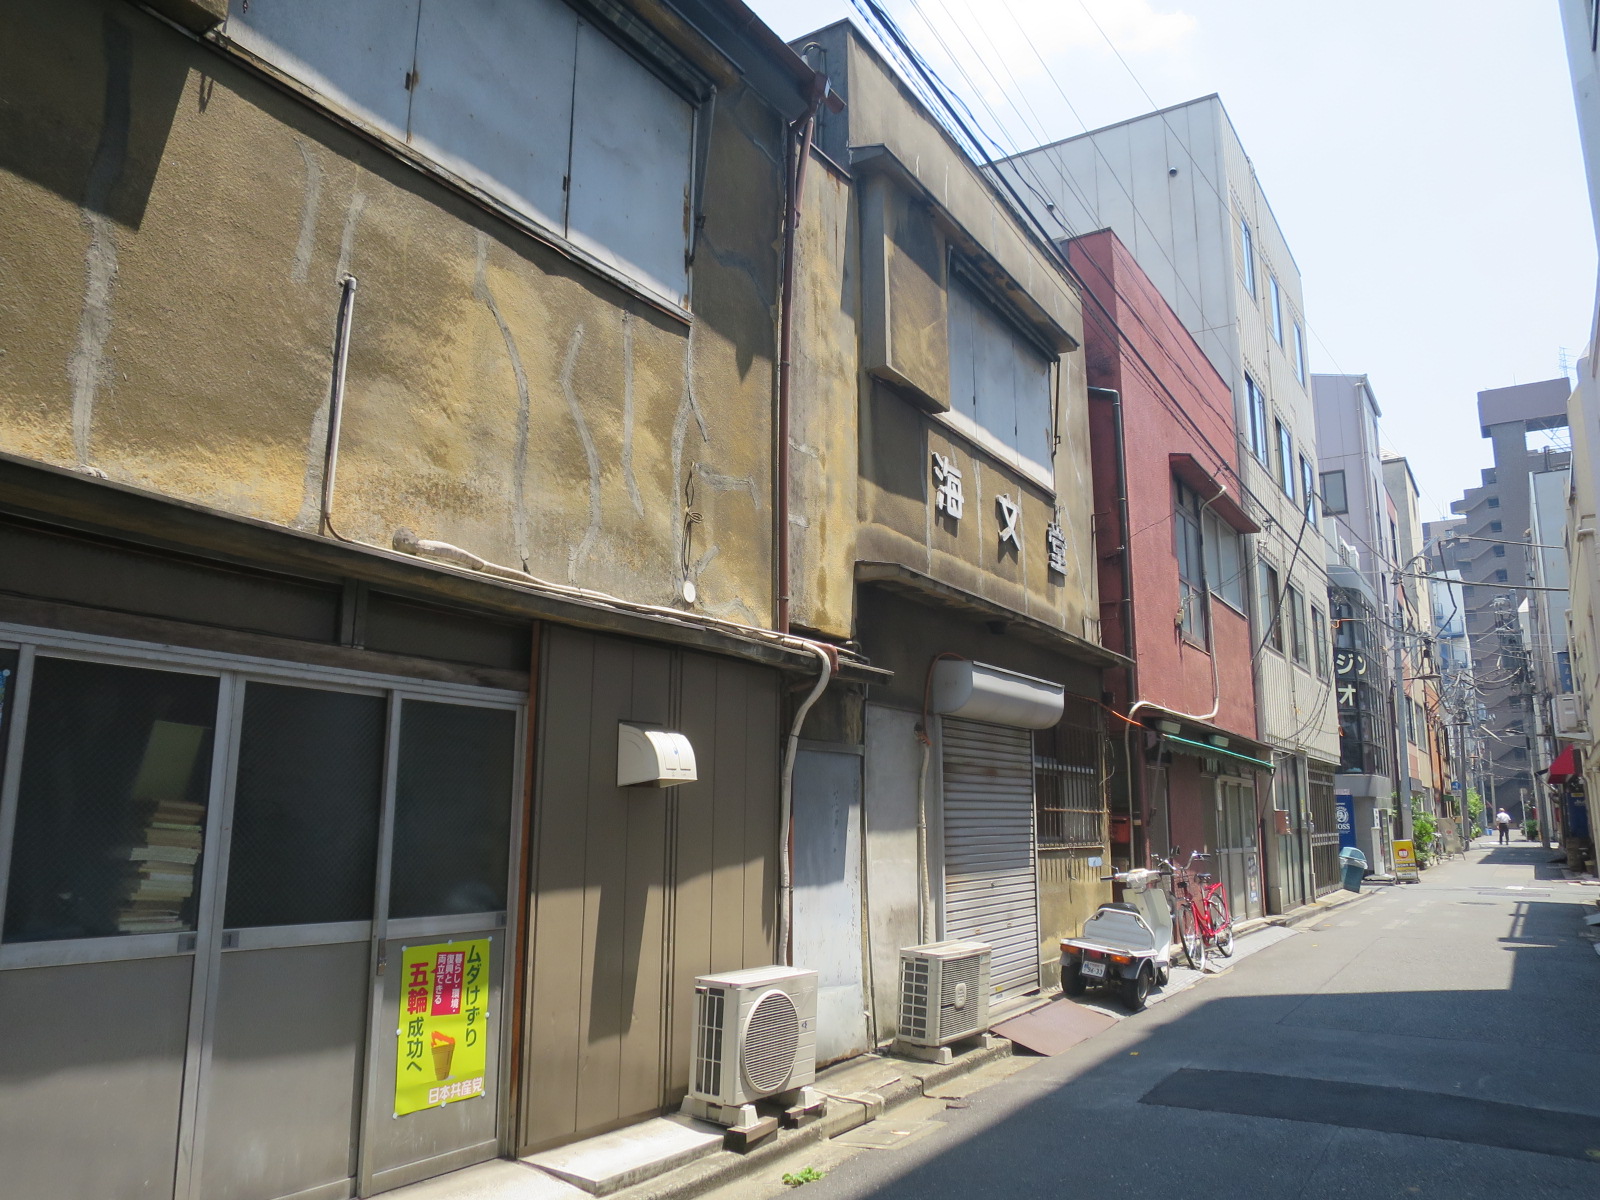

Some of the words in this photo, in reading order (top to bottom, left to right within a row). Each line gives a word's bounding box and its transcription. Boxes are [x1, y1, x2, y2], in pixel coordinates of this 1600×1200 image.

[406, 962, 429, 1072] 五輪成功へ
[434, 954, 446, 1005] 両立できる
[466, 945, 482, 1047] ムダけずり
[428, 1077, 483, 1104] 日本共産党
